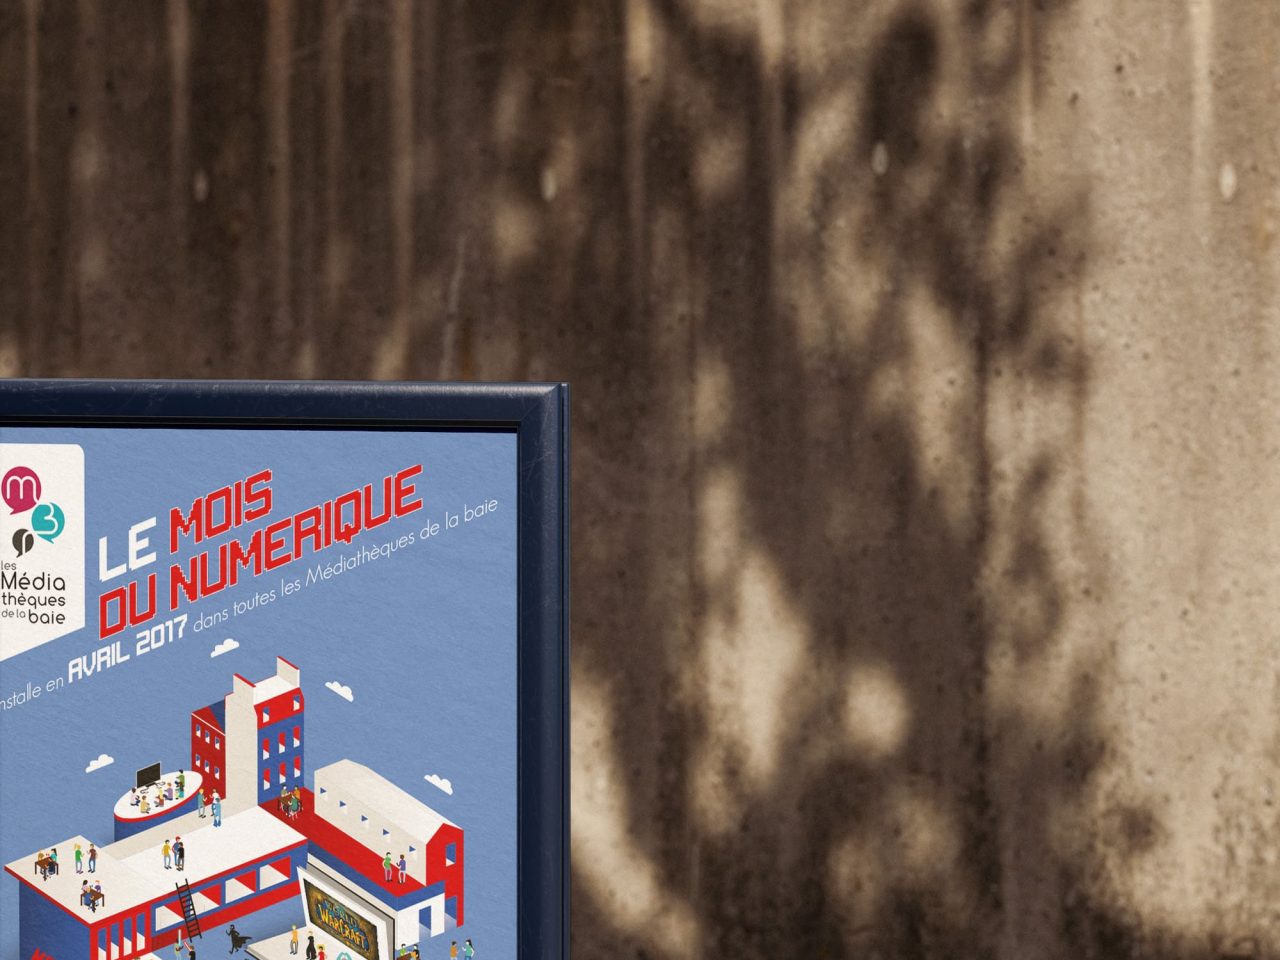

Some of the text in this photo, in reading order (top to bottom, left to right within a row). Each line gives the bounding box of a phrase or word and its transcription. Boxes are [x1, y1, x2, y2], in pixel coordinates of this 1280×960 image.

[99, 469, 272, 583] LE MOIS
[99, 464, 424, 641] DU NUMERIQUE
[1, 560, 17, 571] les
[1, 571, 66, 591] Média
[1, 592, 66, 610] thèques
[46, 678, 64, 692] en
[68, 641, 130, 684] AVRIL
[136, 613, 188, 657] 2017
[193, 610, 229, 633] dans
[233, 590, 276, 616] toutes
[280, 575, 301, 597] les
[305, 534, 415, 588] Médiathèques
[420, 522, 440, 540] de
[445, 511, 460, 532] la
[464, 498, 498, 521] baie
[1, 609, 66, 625] de la baie
